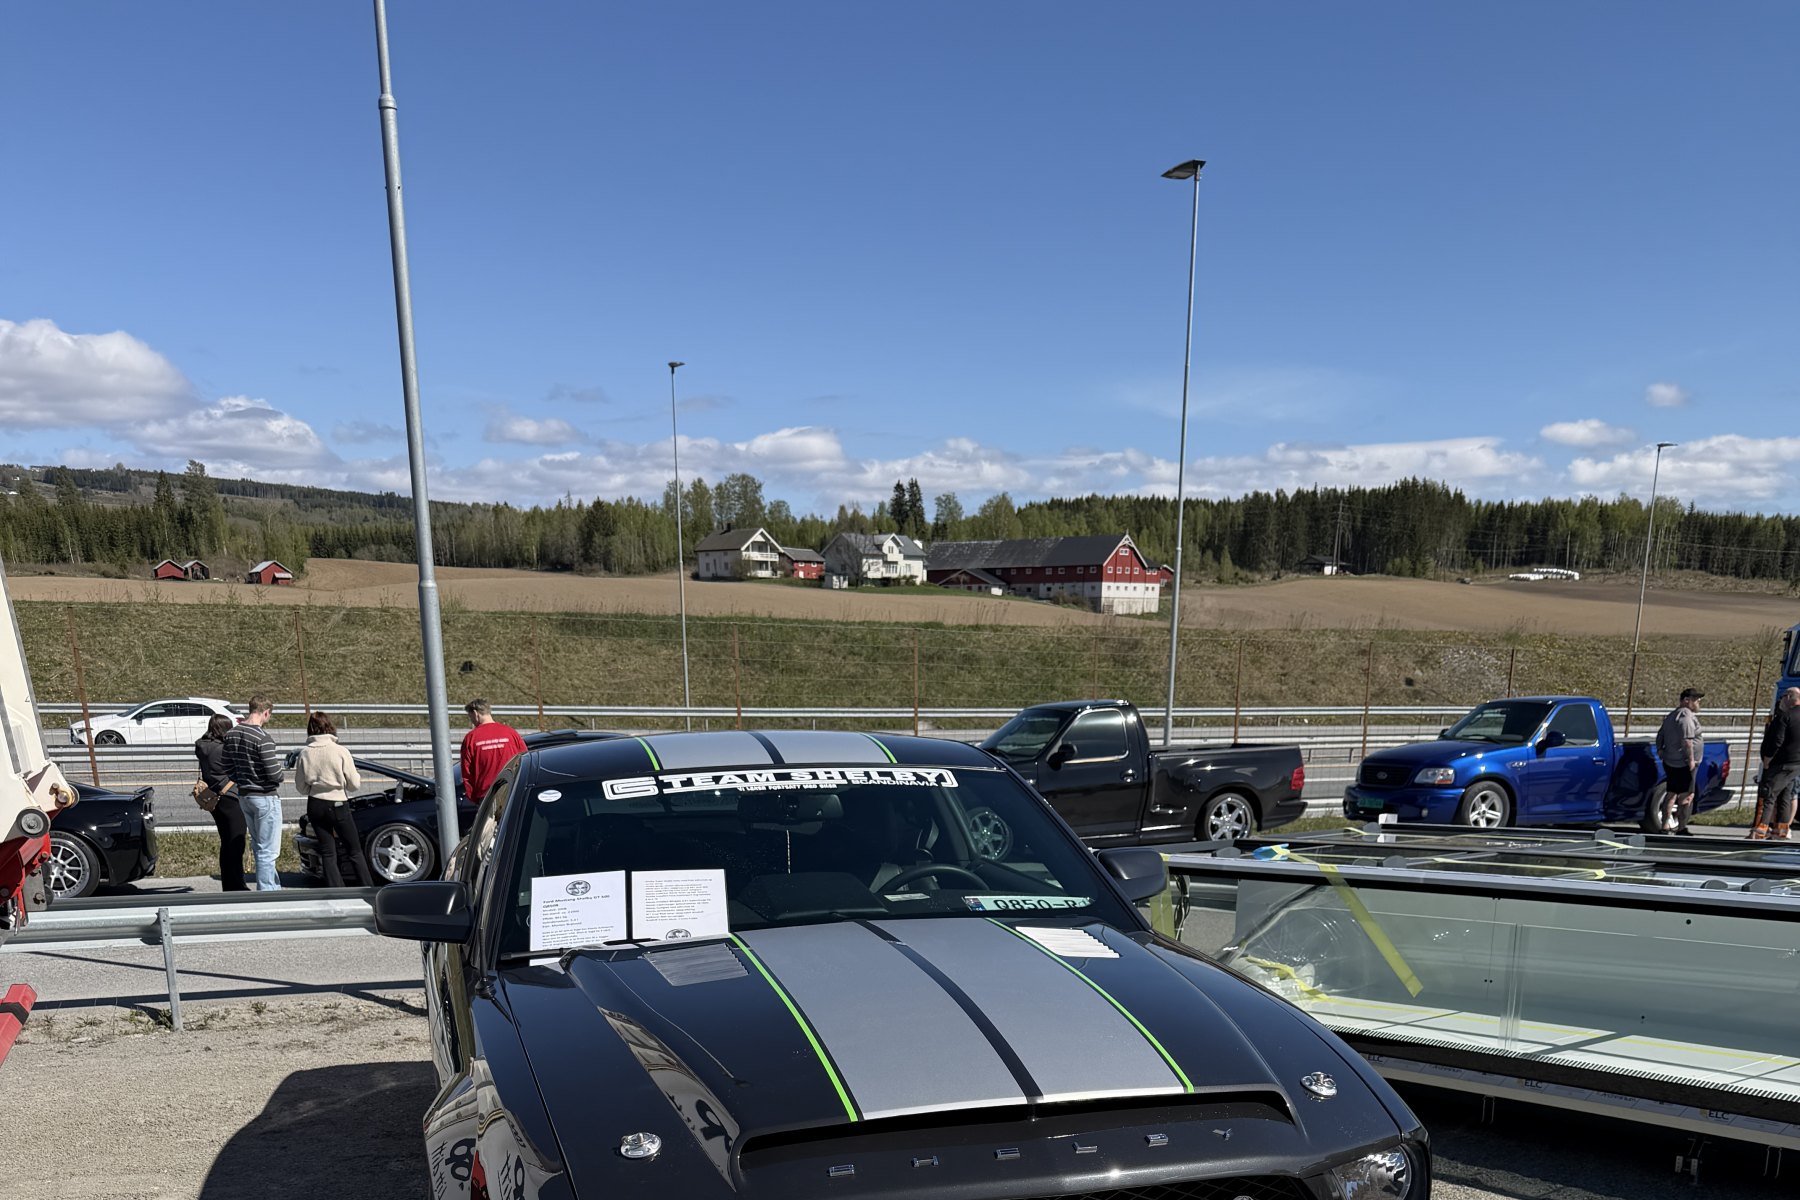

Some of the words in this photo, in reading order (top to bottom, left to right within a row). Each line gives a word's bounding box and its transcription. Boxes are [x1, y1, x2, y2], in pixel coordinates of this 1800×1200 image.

[658, 771, 777, 789] TEAM
[790, 769, 944, 783] SHELBY
[851, 778, 938, 787] SCANDINAVIA
[1524, 1079, 1543, 1089] ELC
[1708, 1110, 1730, 1121] ELC
